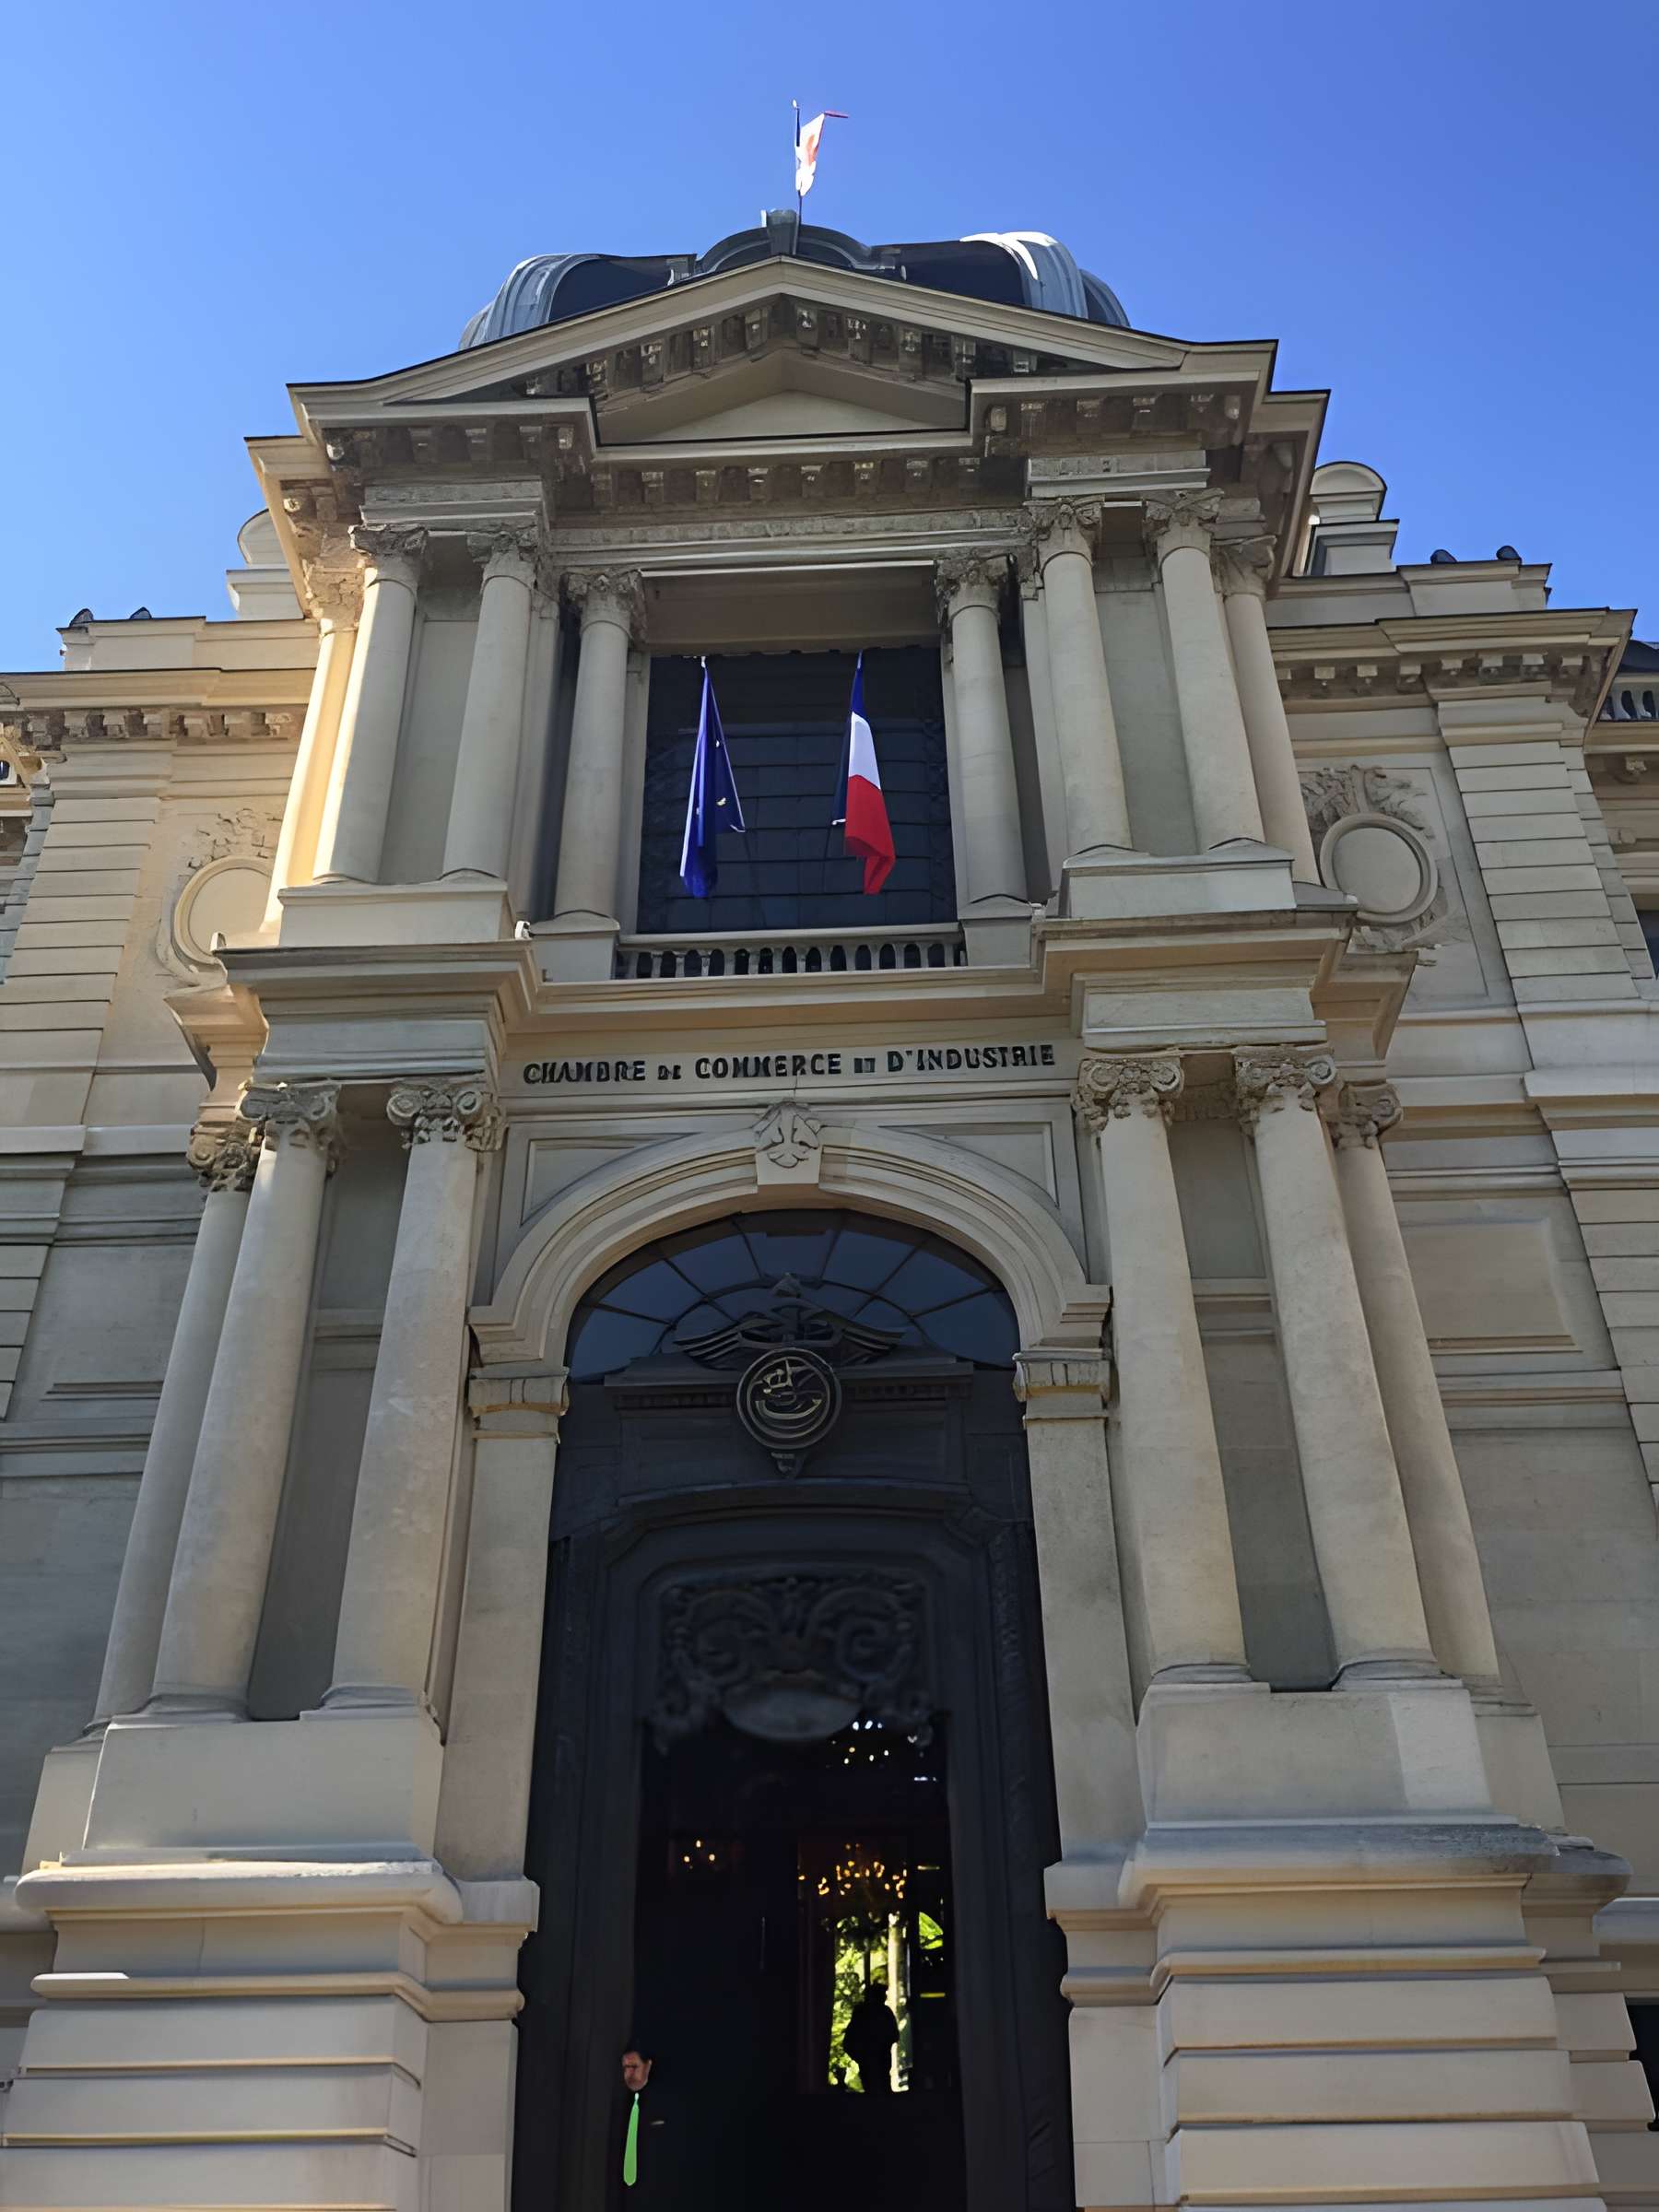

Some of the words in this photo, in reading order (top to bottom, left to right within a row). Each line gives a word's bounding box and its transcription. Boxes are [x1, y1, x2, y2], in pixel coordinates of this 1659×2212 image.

[523, 1060, 645, 1084] CHAMBRE
[658, 1065, 682, 1080] DE
[695, 1053, 842, 1079] COMMERCE
[887, 1044, 1055, 1073] D'INDUSTRIE
